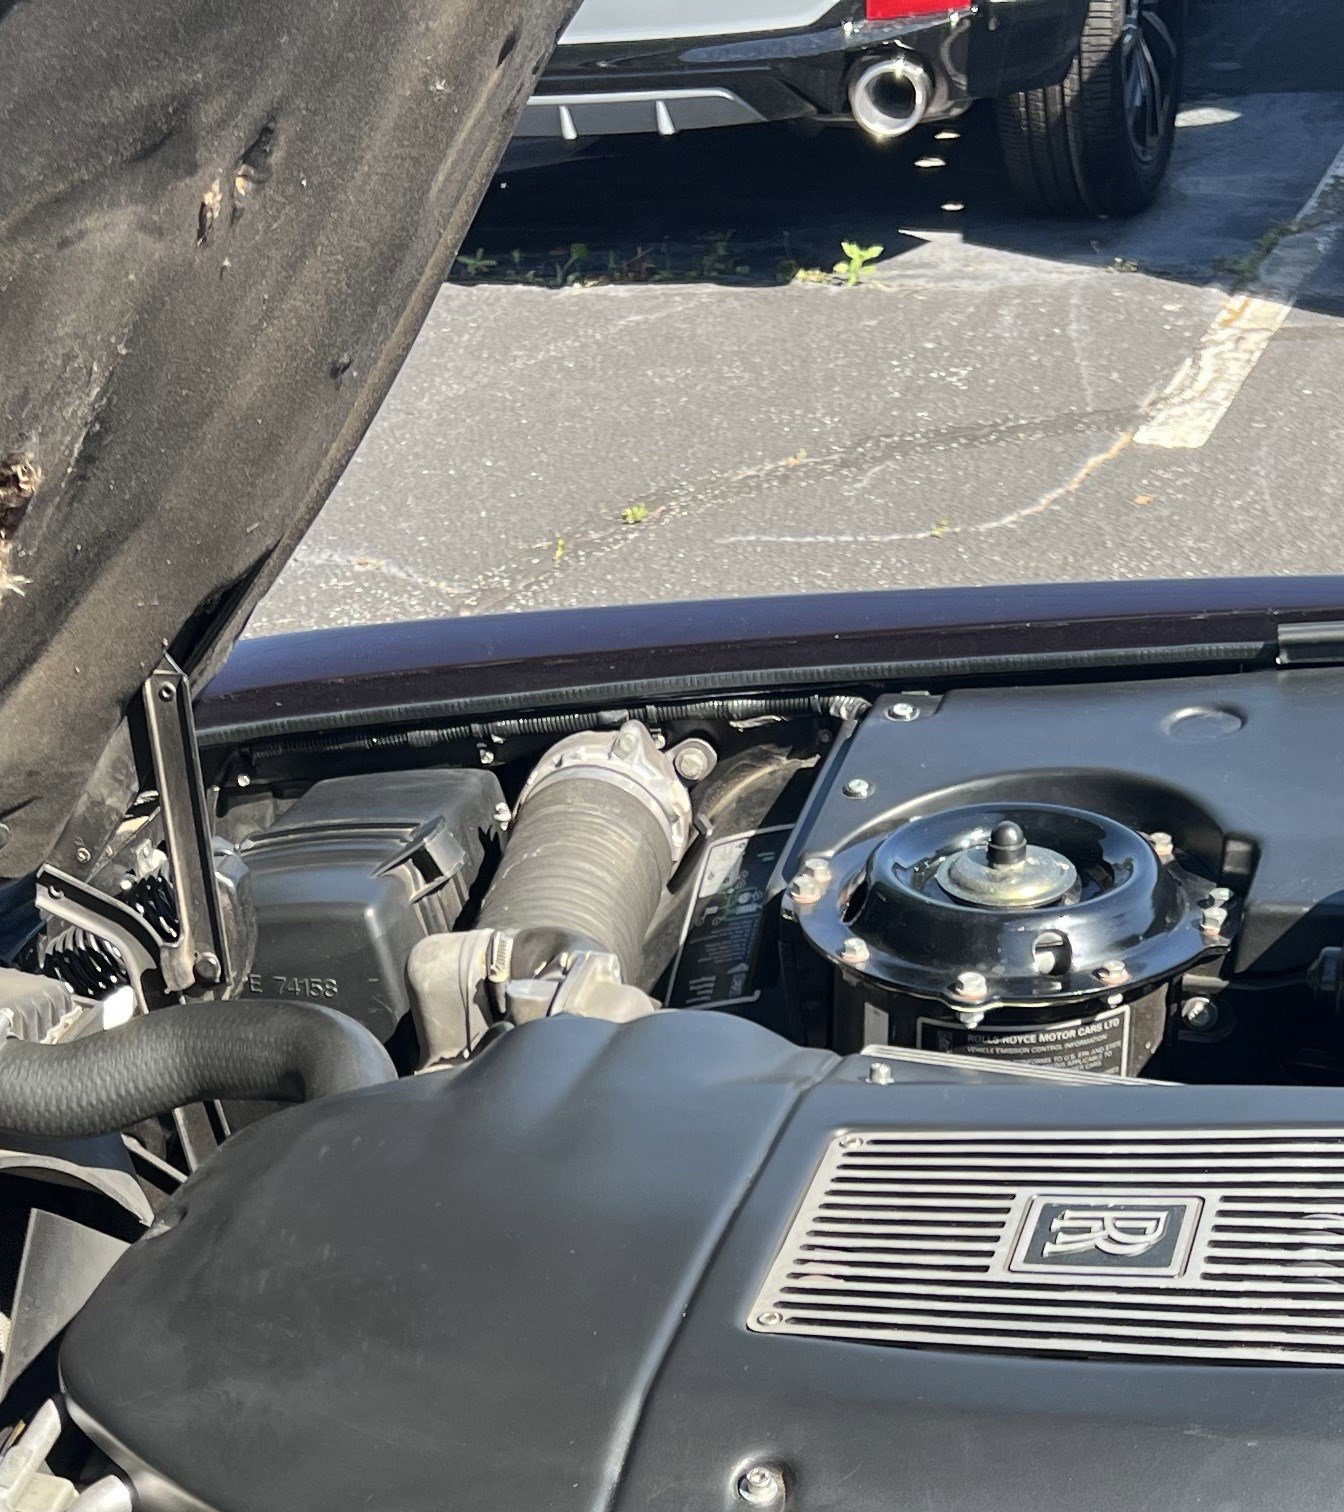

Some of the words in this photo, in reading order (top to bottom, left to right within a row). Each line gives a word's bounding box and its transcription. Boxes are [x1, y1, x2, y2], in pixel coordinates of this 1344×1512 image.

[273, 976, 339, 998] 74158
[1038, 1029, 1076, 1042] MOTOR
[1077, 1022, 1103, 1036] CARS
[1104, 1017, 1120, 1030] LTD
